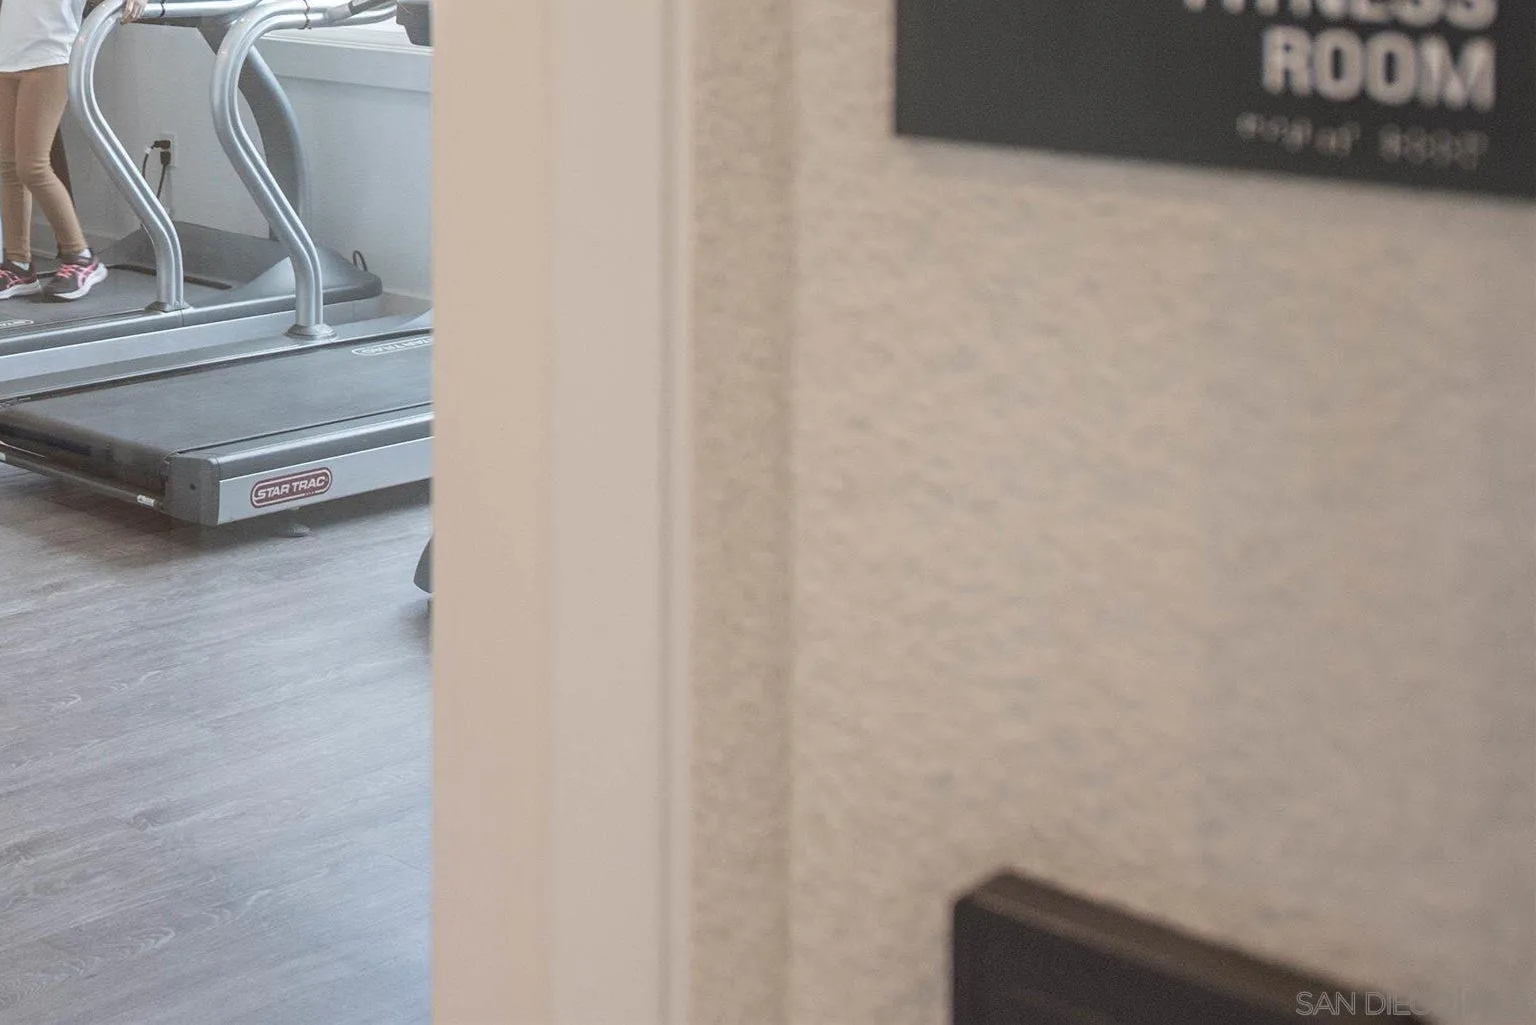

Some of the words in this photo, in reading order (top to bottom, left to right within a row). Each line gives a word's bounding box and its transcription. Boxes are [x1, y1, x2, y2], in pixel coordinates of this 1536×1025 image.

[1262, 24, 1497, 113] ROOM
[256, 483, 290, 500] STAR
[291, 476, 326, 493] TRAC
